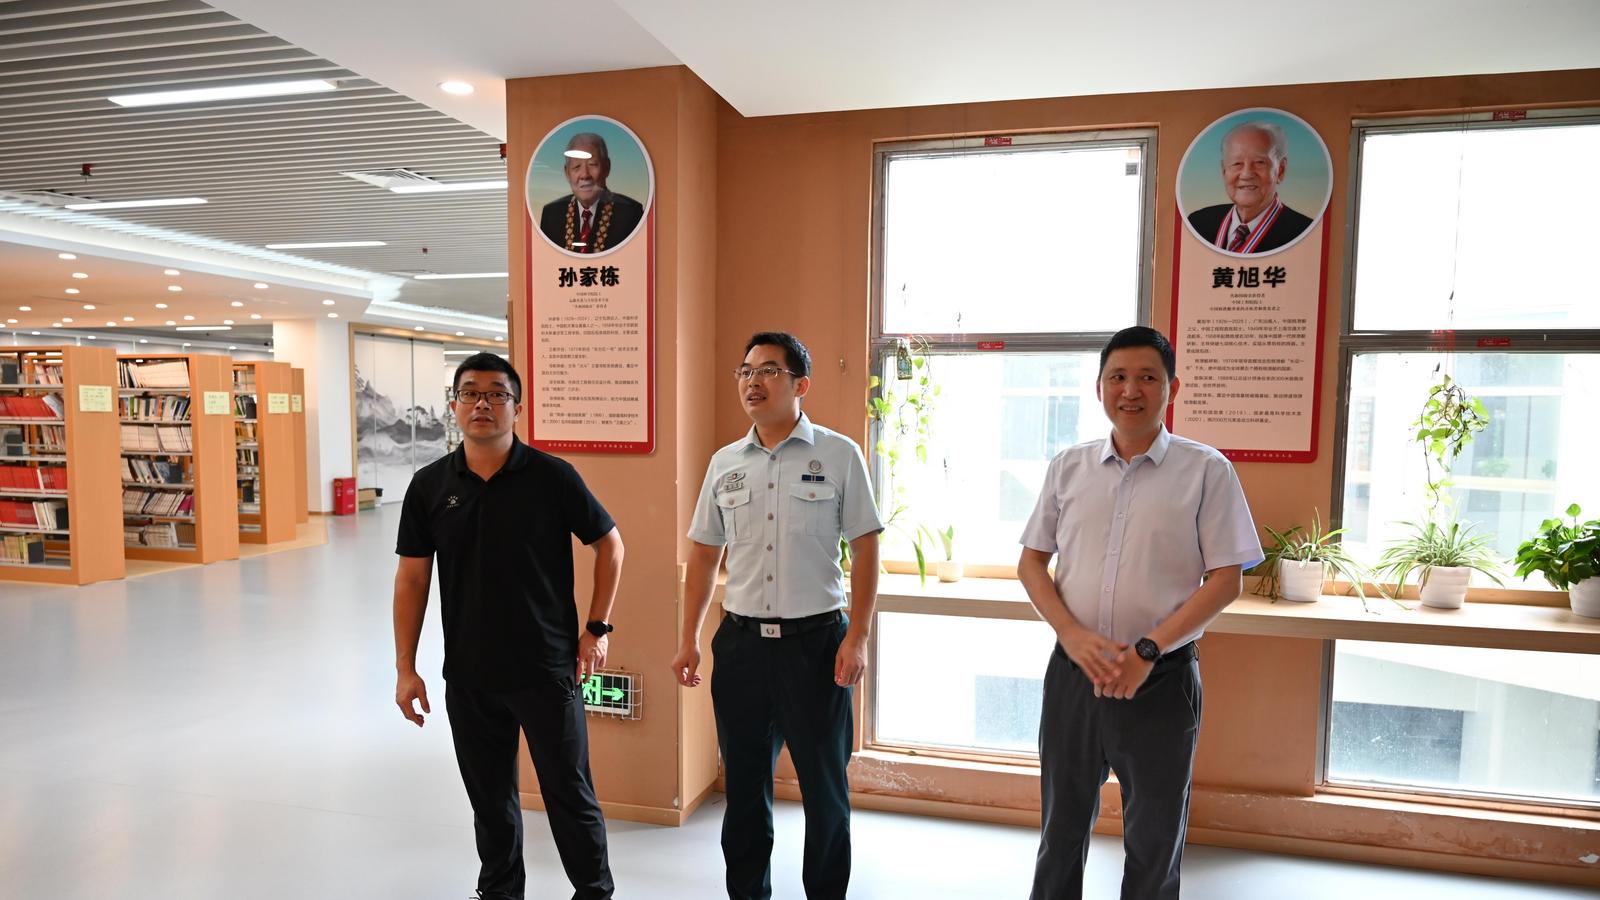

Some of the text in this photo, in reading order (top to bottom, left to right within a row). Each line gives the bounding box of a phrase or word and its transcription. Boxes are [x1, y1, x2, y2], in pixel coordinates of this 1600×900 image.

[558, 266, 620, 288] 孙家栋
[1212, 266, 1286, 289] 黄旭华
